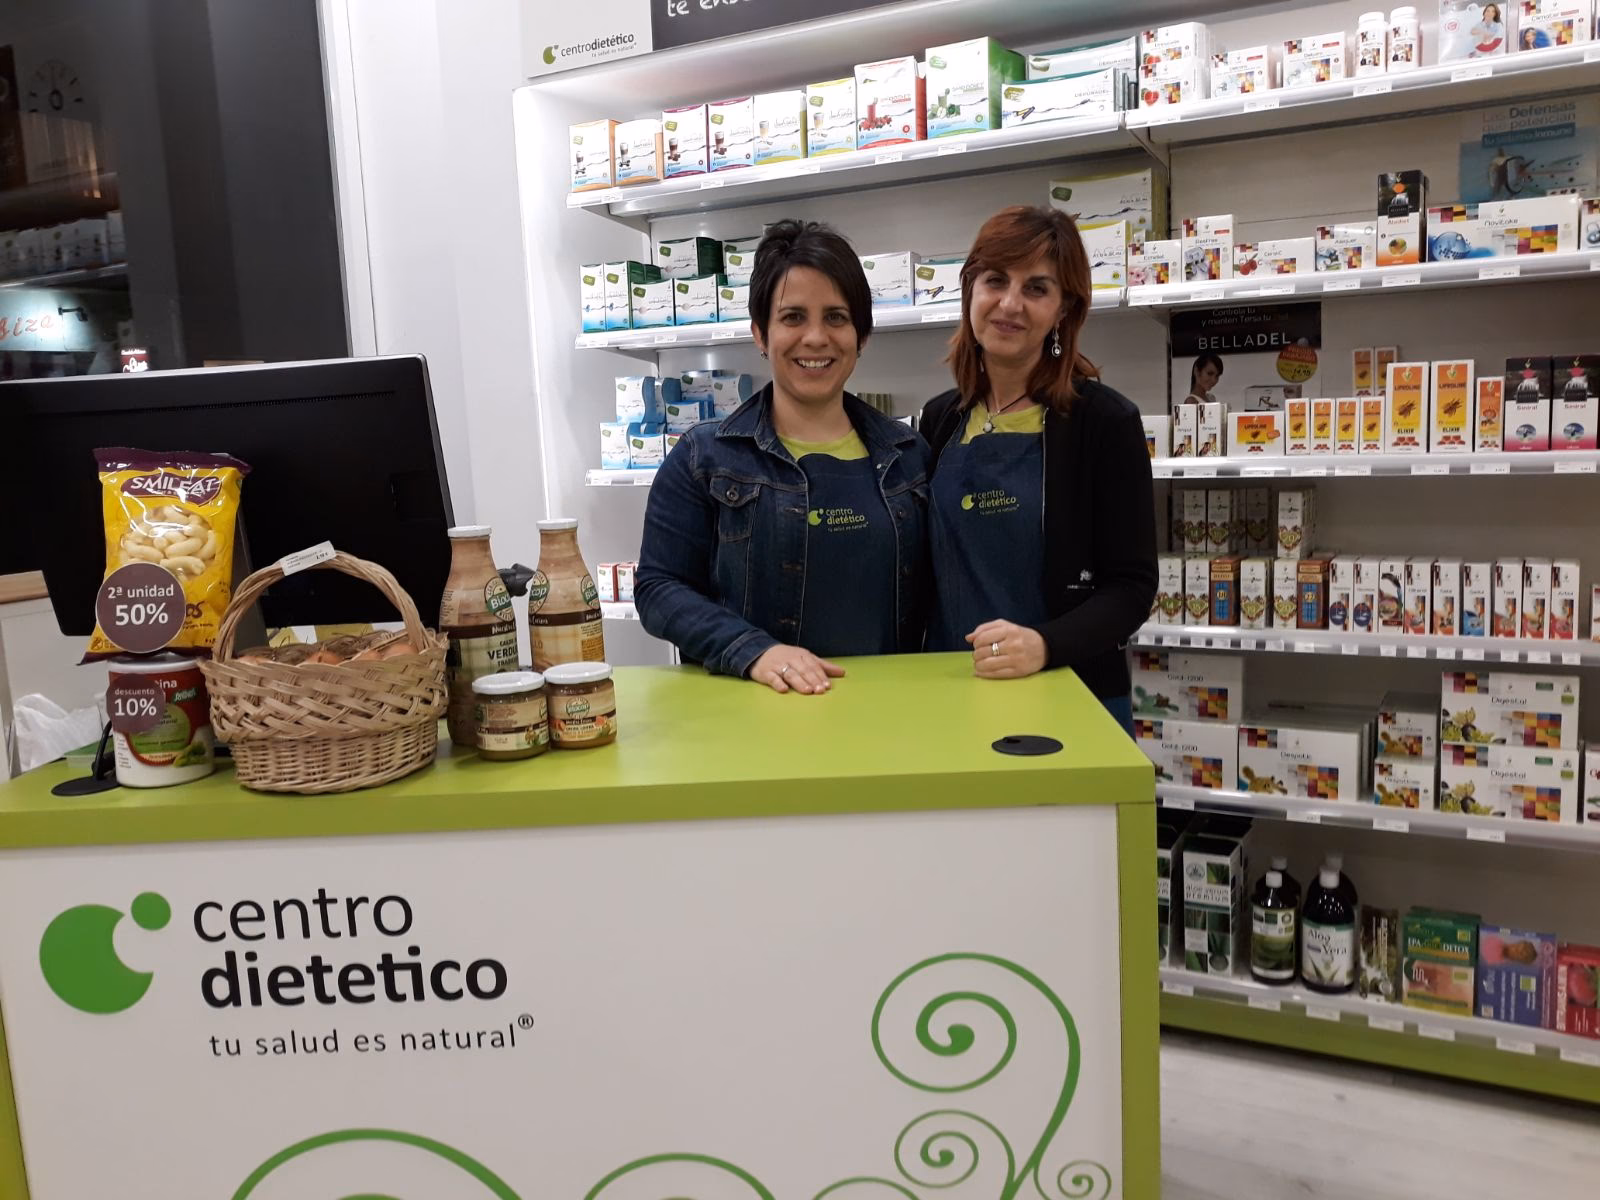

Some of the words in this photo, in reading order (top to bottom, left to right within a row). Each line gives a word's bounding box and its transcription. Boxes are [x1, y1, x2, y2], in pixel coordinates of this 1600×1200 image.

[667, 0, 690, 17] te
[1509, 101, 1577, 119] Defensas
[1198, 332, 1292, 350] BELLADEL
[130, 476, 218, 497] SMILEAT
[977, 489, 1005, 500] centro
[825, 508, 853, 517] centro
[107, 586, 123, 599] 2ª
[127, 584, 174, 598] unidad
[115, 602, 169, 626] 50%
[487, 646, 518, 661] VERDU
[114, 687, 155, 696] descuento
[114, 698, 157, 717] 10%
[194, 889, 413, 942] centro
[1308, 928, 1331, 941] Aloe
[1321, 943, 1347, 955] Vera
[202, 946, 507, 1008] dietetico
[209, 1036, 240, 1056] tu
[256, 1029, 338, 1055] salud
[354, 1035, 386, 1052] es
